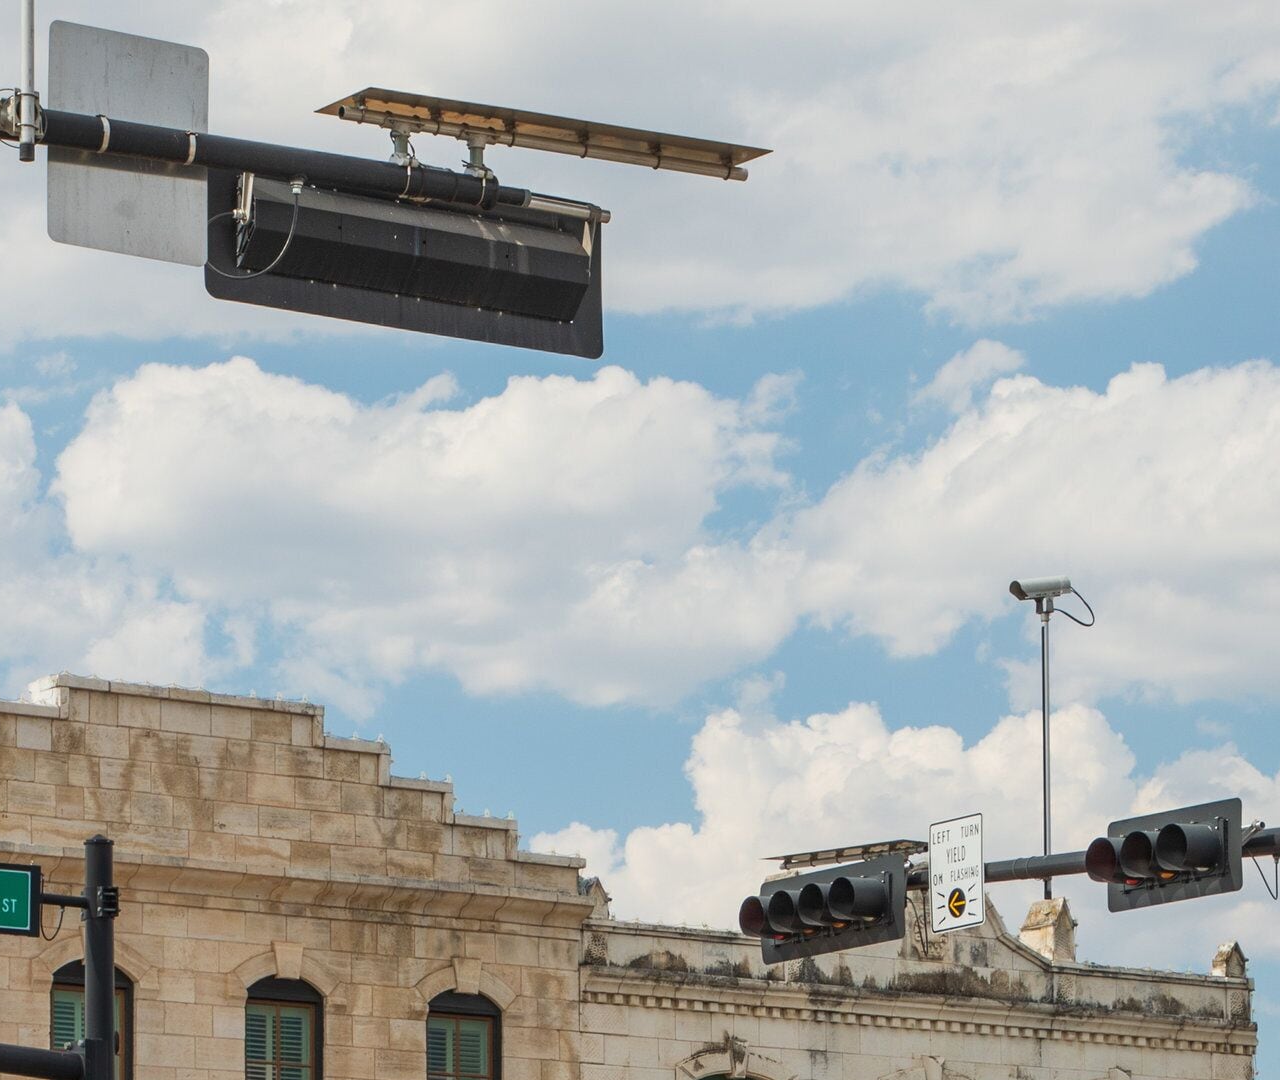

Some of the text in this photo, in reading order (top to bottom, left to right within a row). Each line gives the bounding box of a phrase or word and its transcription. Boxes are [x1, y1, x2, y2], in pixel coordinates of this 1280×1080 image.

[932, 823, 980, 845] LEFT TURN
[946, 845, 966, 864] YIELD
[950, 865, 979, 882] FLASHING
[2, 898, 18, 913] ST
